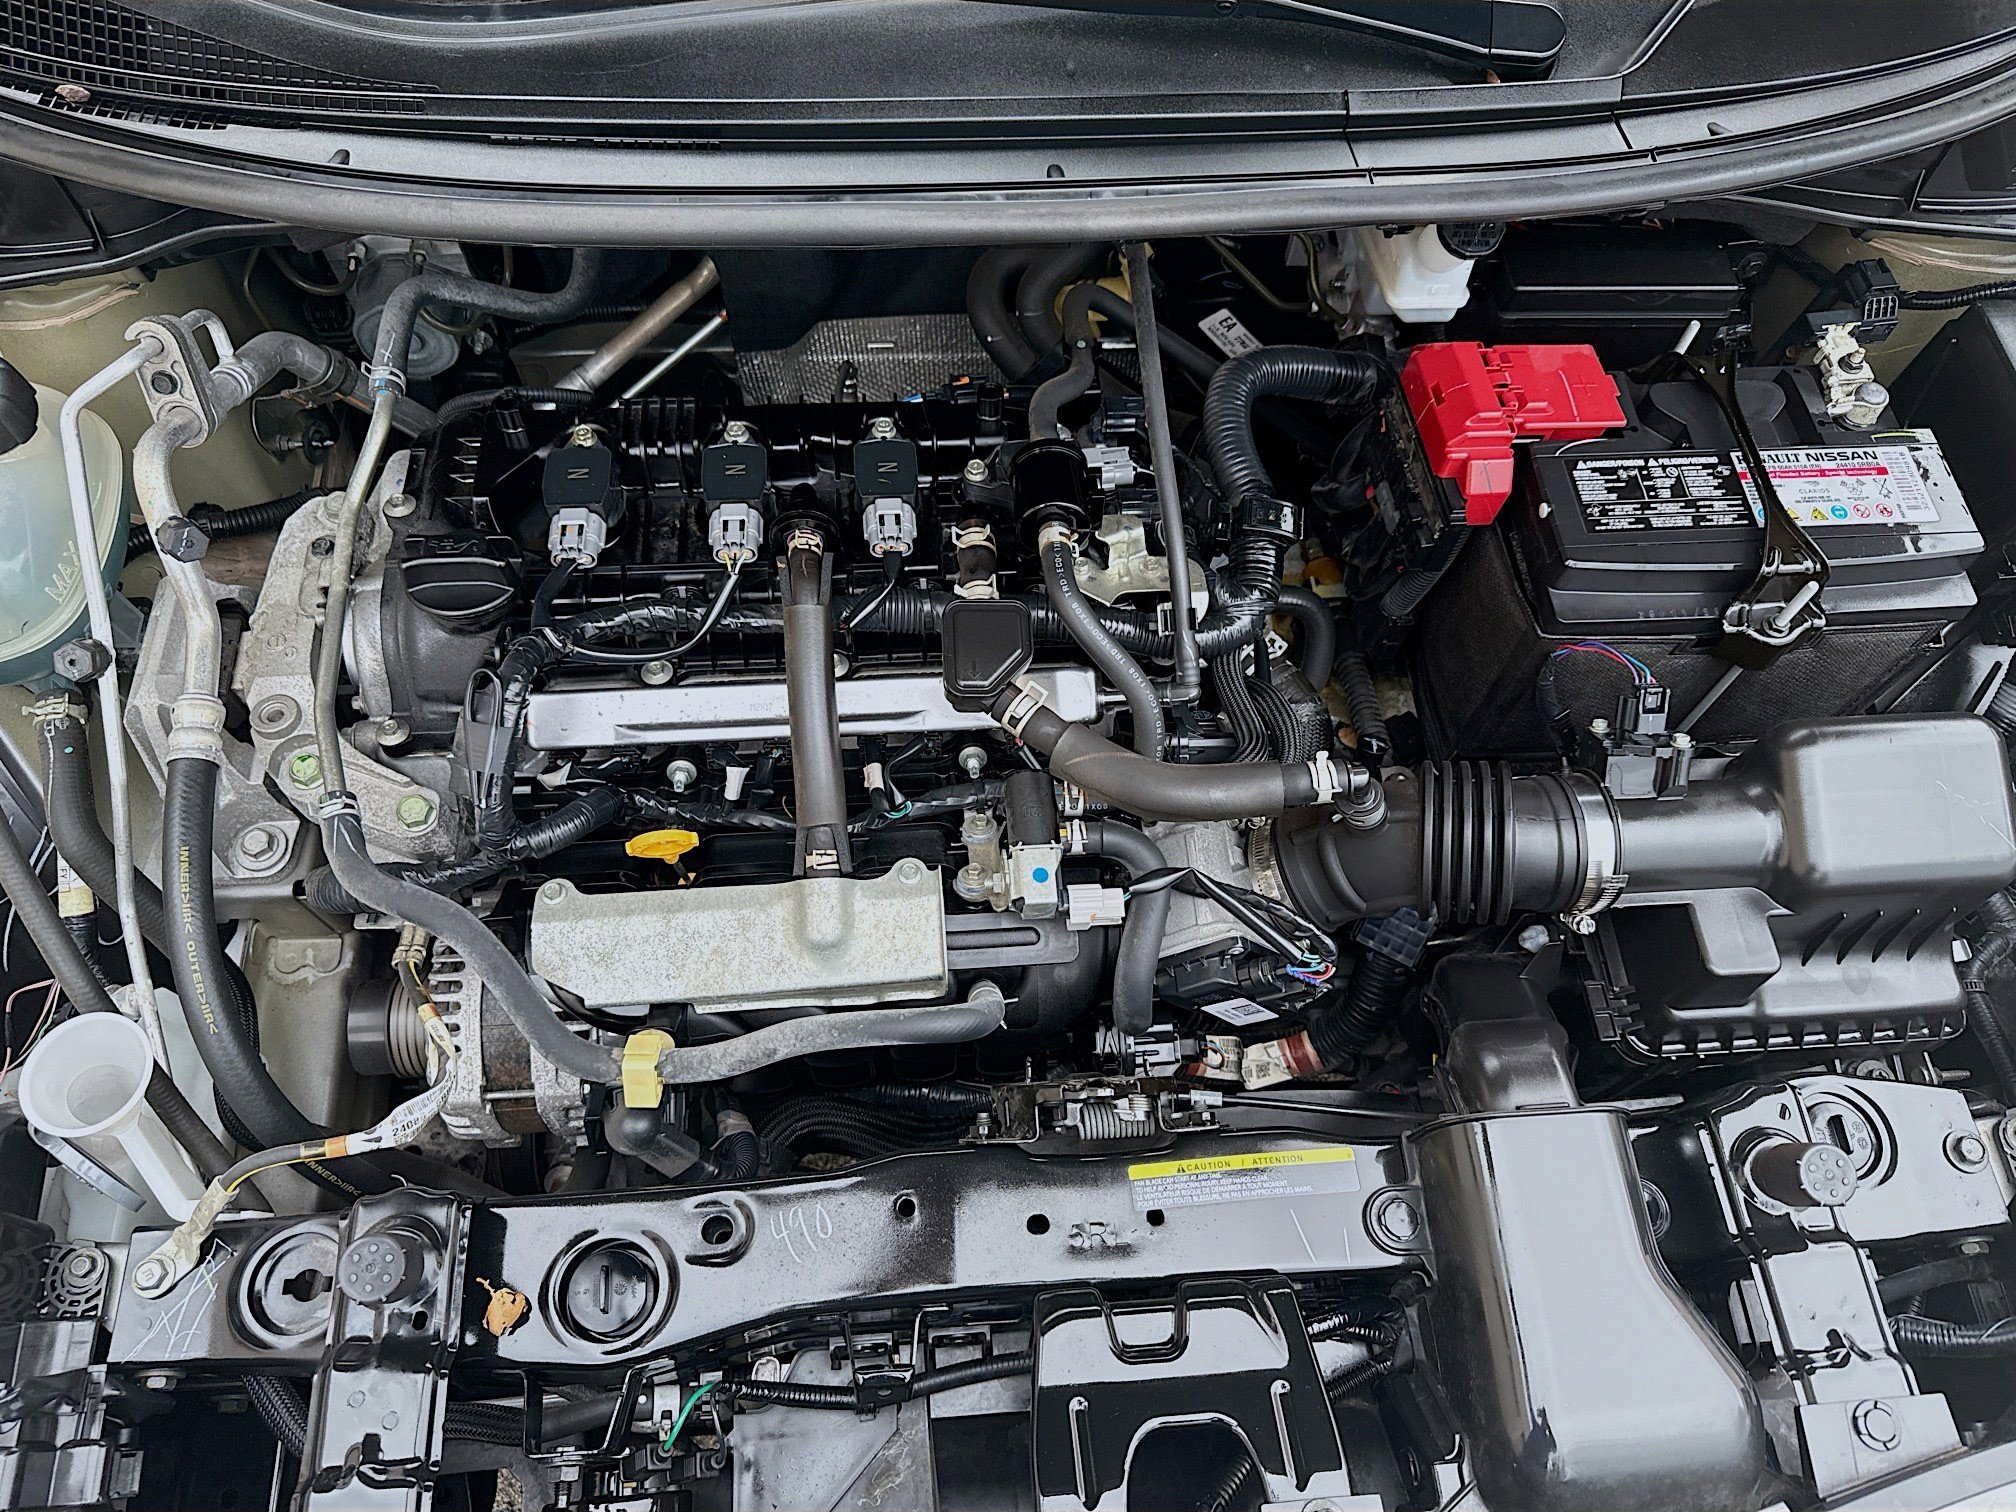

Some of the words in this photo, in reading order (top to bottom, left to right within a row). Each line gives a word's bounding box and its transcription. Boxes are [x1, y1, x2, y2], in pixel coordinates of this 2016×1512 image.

[1218, 316, 1237, 332] EA
[1736, 452, 1801, 465] RAULT
[1806, 450, 1878, 462] NISSAN
[44, 540, 80, 602] MAX
[1187, 1160, 1231, 1172] CAUTION
[1252, 1154, 1303, 1166] ATTENTION
[305, 1160, 362, 1197] NNER>IIR<
[1174, 1181, 1200, 1189] PERSONAL
[1137, 1199, 1154, 1207] POUR
[1250, 1187, 1283, 1196] APPROCHER
[1143, 1190, 1180, 1199] VENTILATEUR
[1181, 1188, 1202, 1196] RISQUE
[1247, 1182, 1261, 1190] TOUT
[770, 1202, 833, 1264] 490
